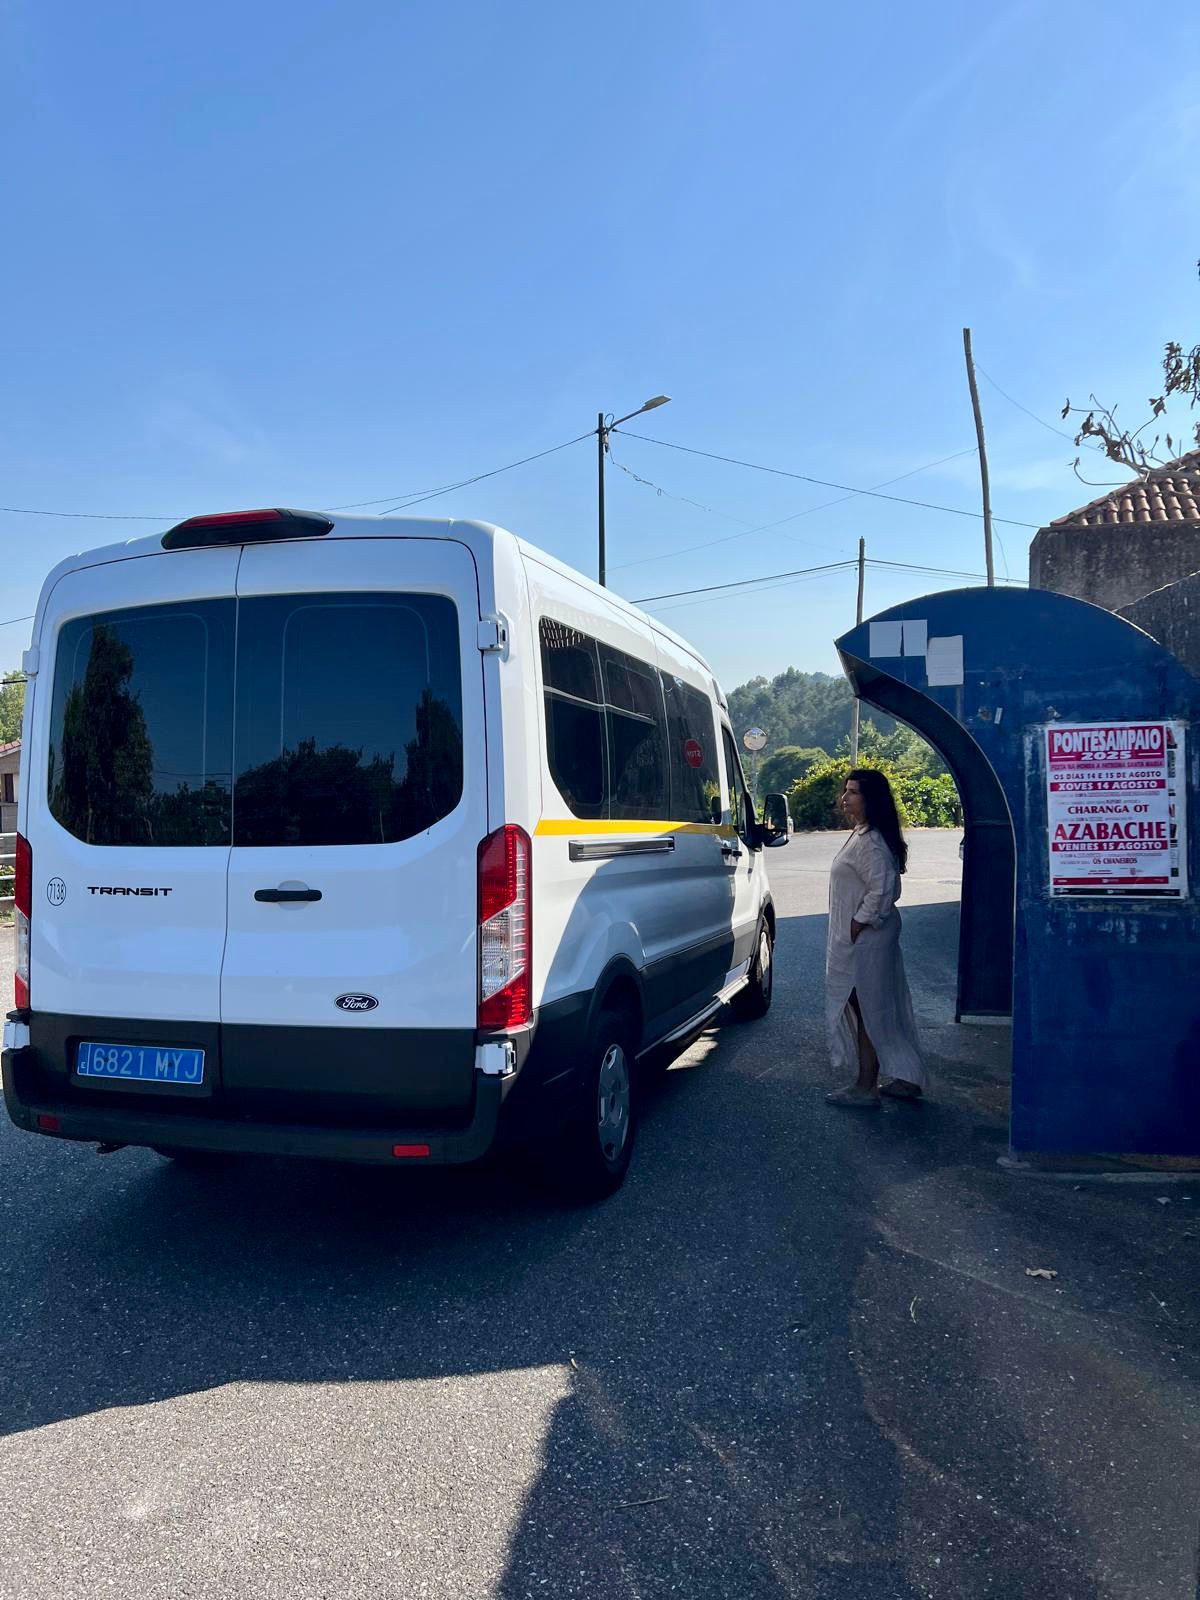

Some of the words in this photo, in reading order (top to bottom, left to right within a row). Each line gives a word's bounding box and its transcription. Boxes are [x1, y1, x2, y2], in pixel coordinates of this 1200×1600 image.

[1054, 729, 1161, 752] PONTESAMPAIO
[1081, 751, 1132, 760] 2025
[1058, 782, 1093, 791] XOVES
[1097, 782, 1109, 790] 14
[1112, 780, 1157, 789] AGOSTO
[1068, 804, 1129, 814] CHARANGA
[1134, 804, 1149, 813] OT
[1055, 821, 1166, 840] AZABACHE
[1058, 843, 1099, 851] VENRES
[1103, 842, 1114, 850] 15
[1119, 841, 1161, 850] AGOSTO
[49, 883, 65, 900] 7138
[87, 886, 173, 896] TRANSIT
[342, 997, 369, 1009] Ford
[80, 1061, 86, 1069] E
[93, 1048, 144, 1076] 6821
[155, 1051, 199, 1079] MYJ
